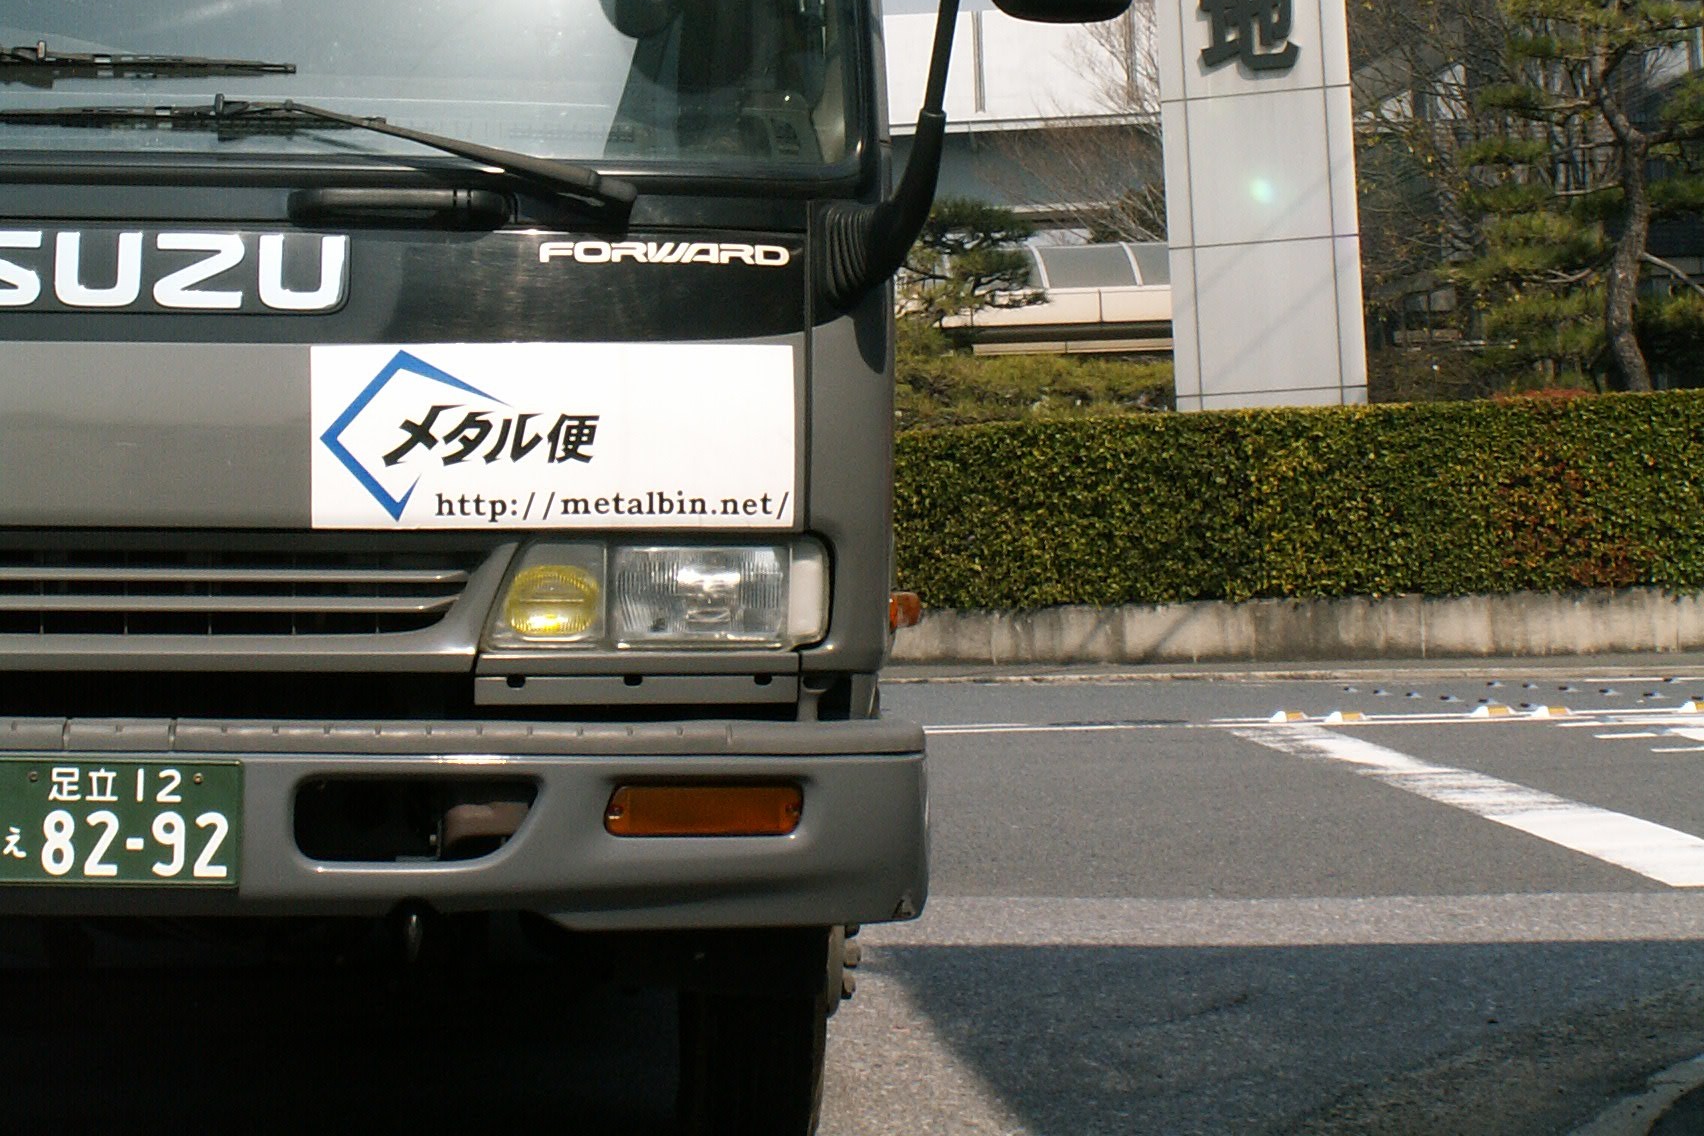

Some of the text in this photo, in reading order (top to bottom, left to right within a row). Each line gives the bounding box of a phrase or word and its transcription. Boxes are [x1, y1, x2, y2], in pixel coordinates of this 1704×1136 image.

[538, 240, 791, 267] FORWARD
[381, 404, 600, 467] メタル便
[435, 490, 790, 523] http://metalbin.net/
[48, 766, 183, 803] 足立 12
[3, 809, 229, 878] え 82-92
